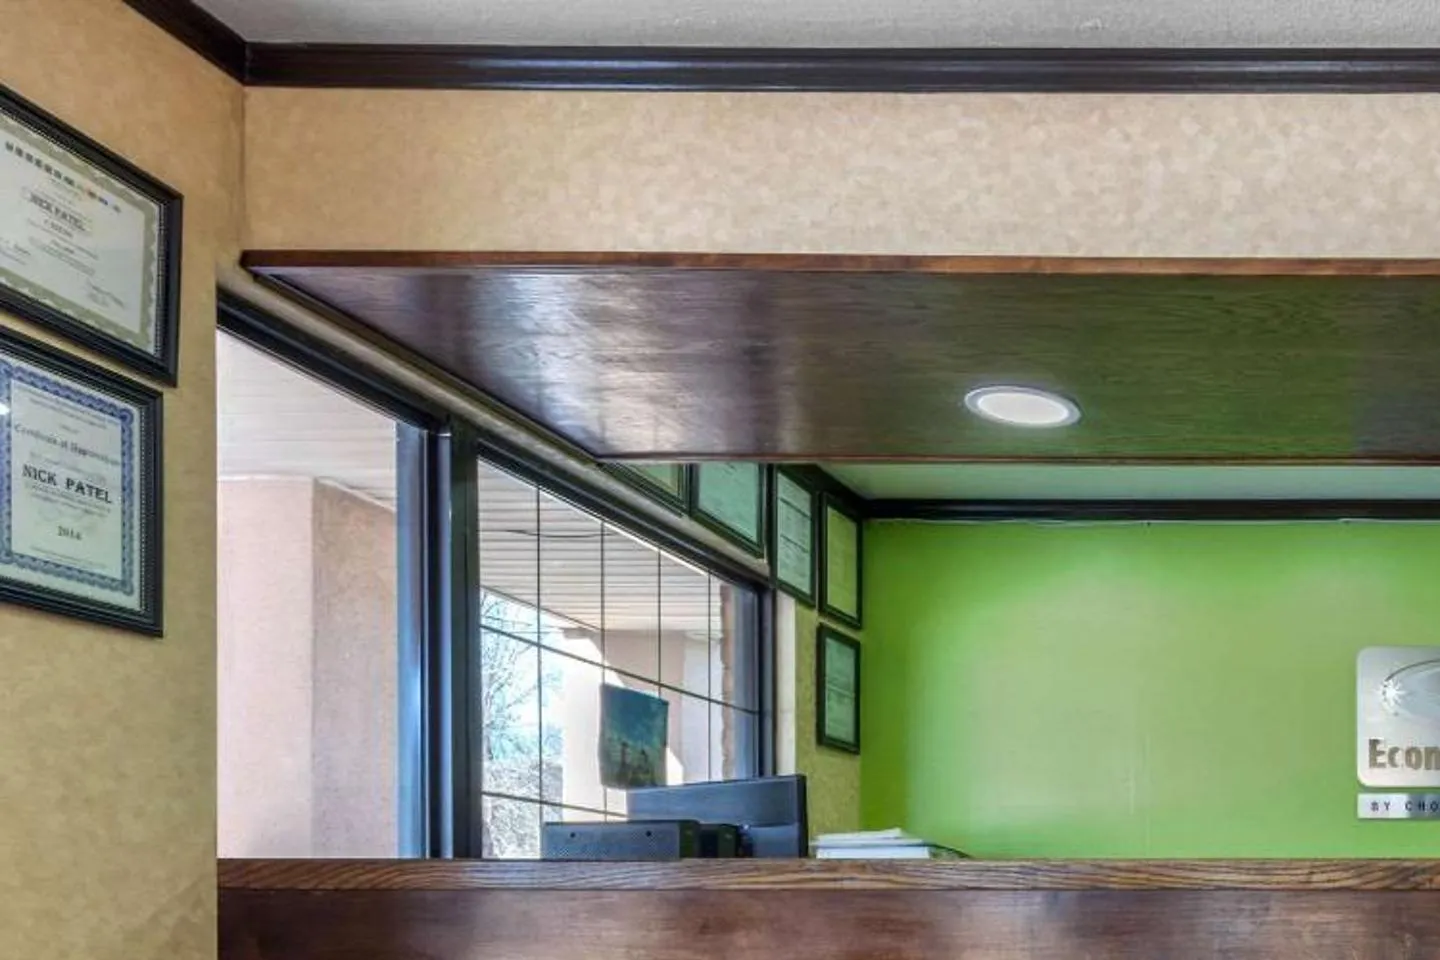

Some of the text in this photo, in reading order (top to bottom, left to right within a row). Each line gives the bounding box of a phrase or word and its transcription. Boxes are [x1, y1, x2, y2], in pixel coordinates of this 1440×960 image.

[22, 463, 57, 486] NICK
[65, 477, 112, 504] PATEL
[1370, 801, 1392, 812] BY
